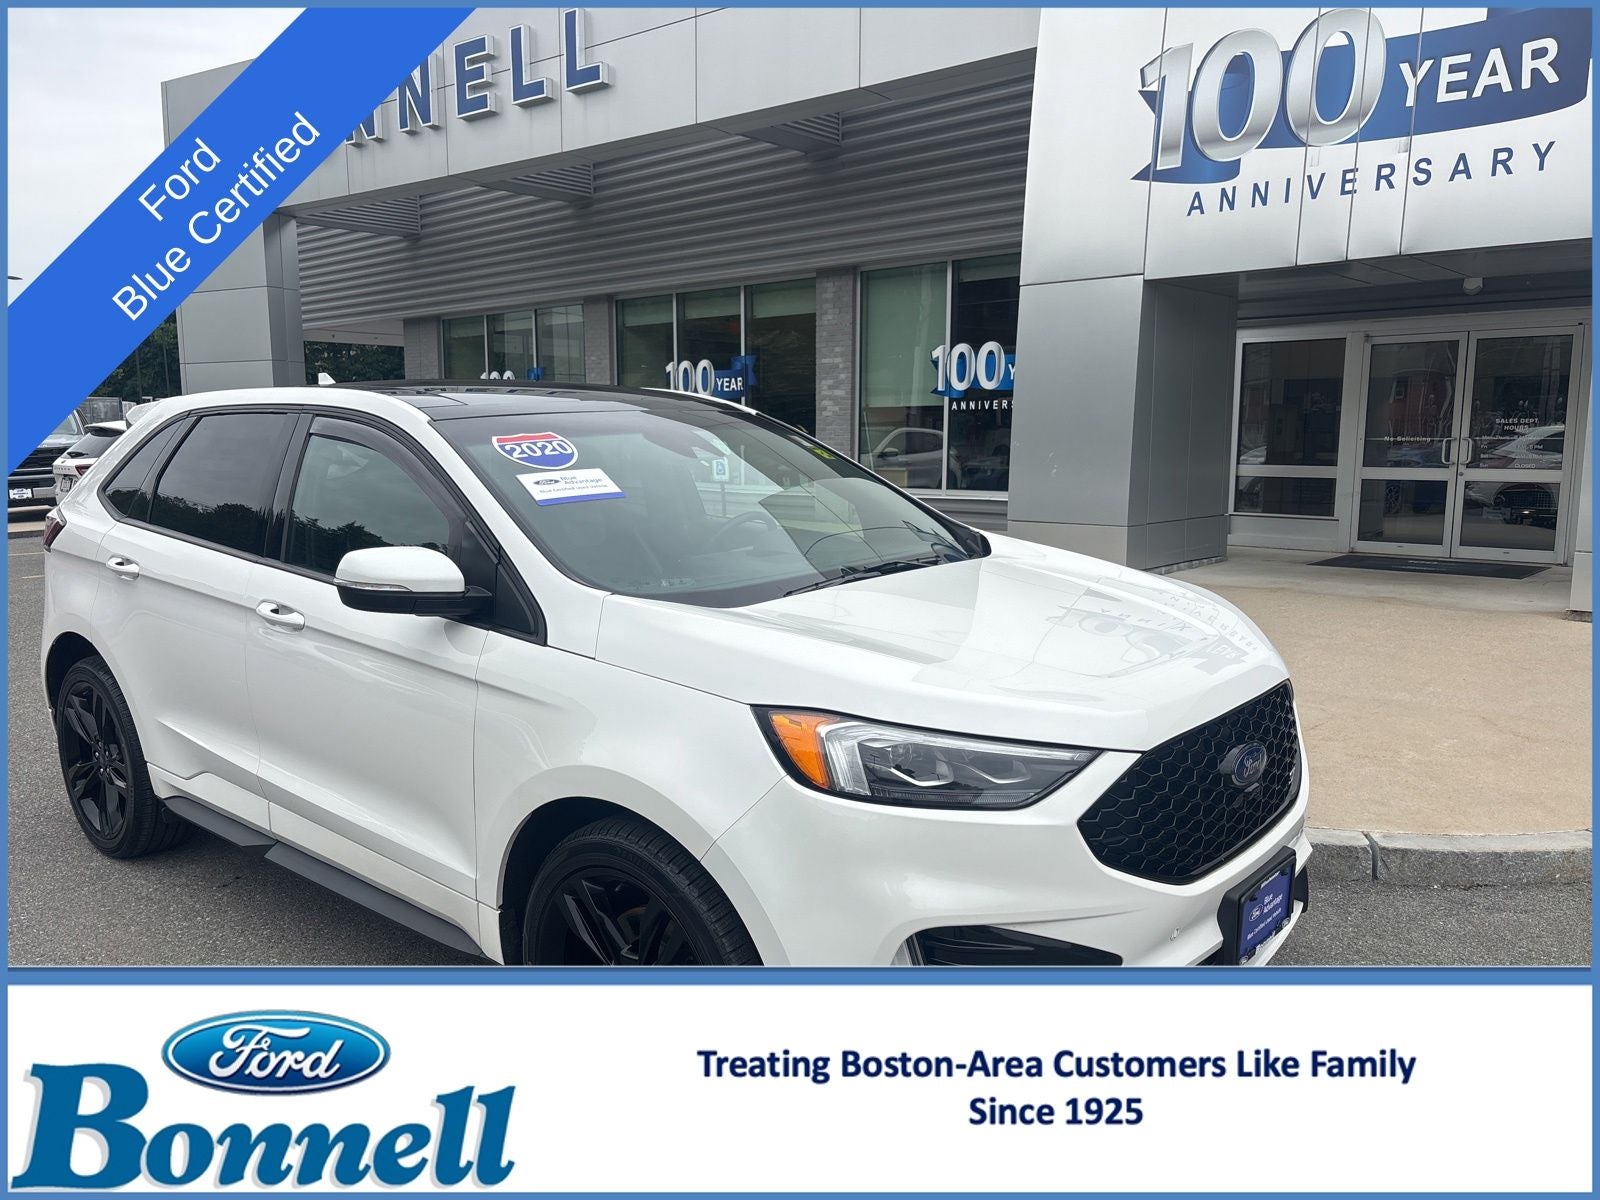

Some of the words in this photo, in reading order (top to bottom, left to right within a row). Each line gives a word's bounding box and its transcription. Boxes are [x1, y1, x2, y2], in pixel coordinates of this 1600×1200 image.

[1140, 8, 1387, 171] 100
[1399, 37, 1560, 107] YEAR
[1187, 141, 1556, 217] ANNIVERSARY
[665, 359, 715, 396] 100
[716, 377, 743, 391] YEAR
[931, 341, 1005, 391] 100
[504, 440, 573, 458] 2020
[564, 478, 603, 486] Advantage
